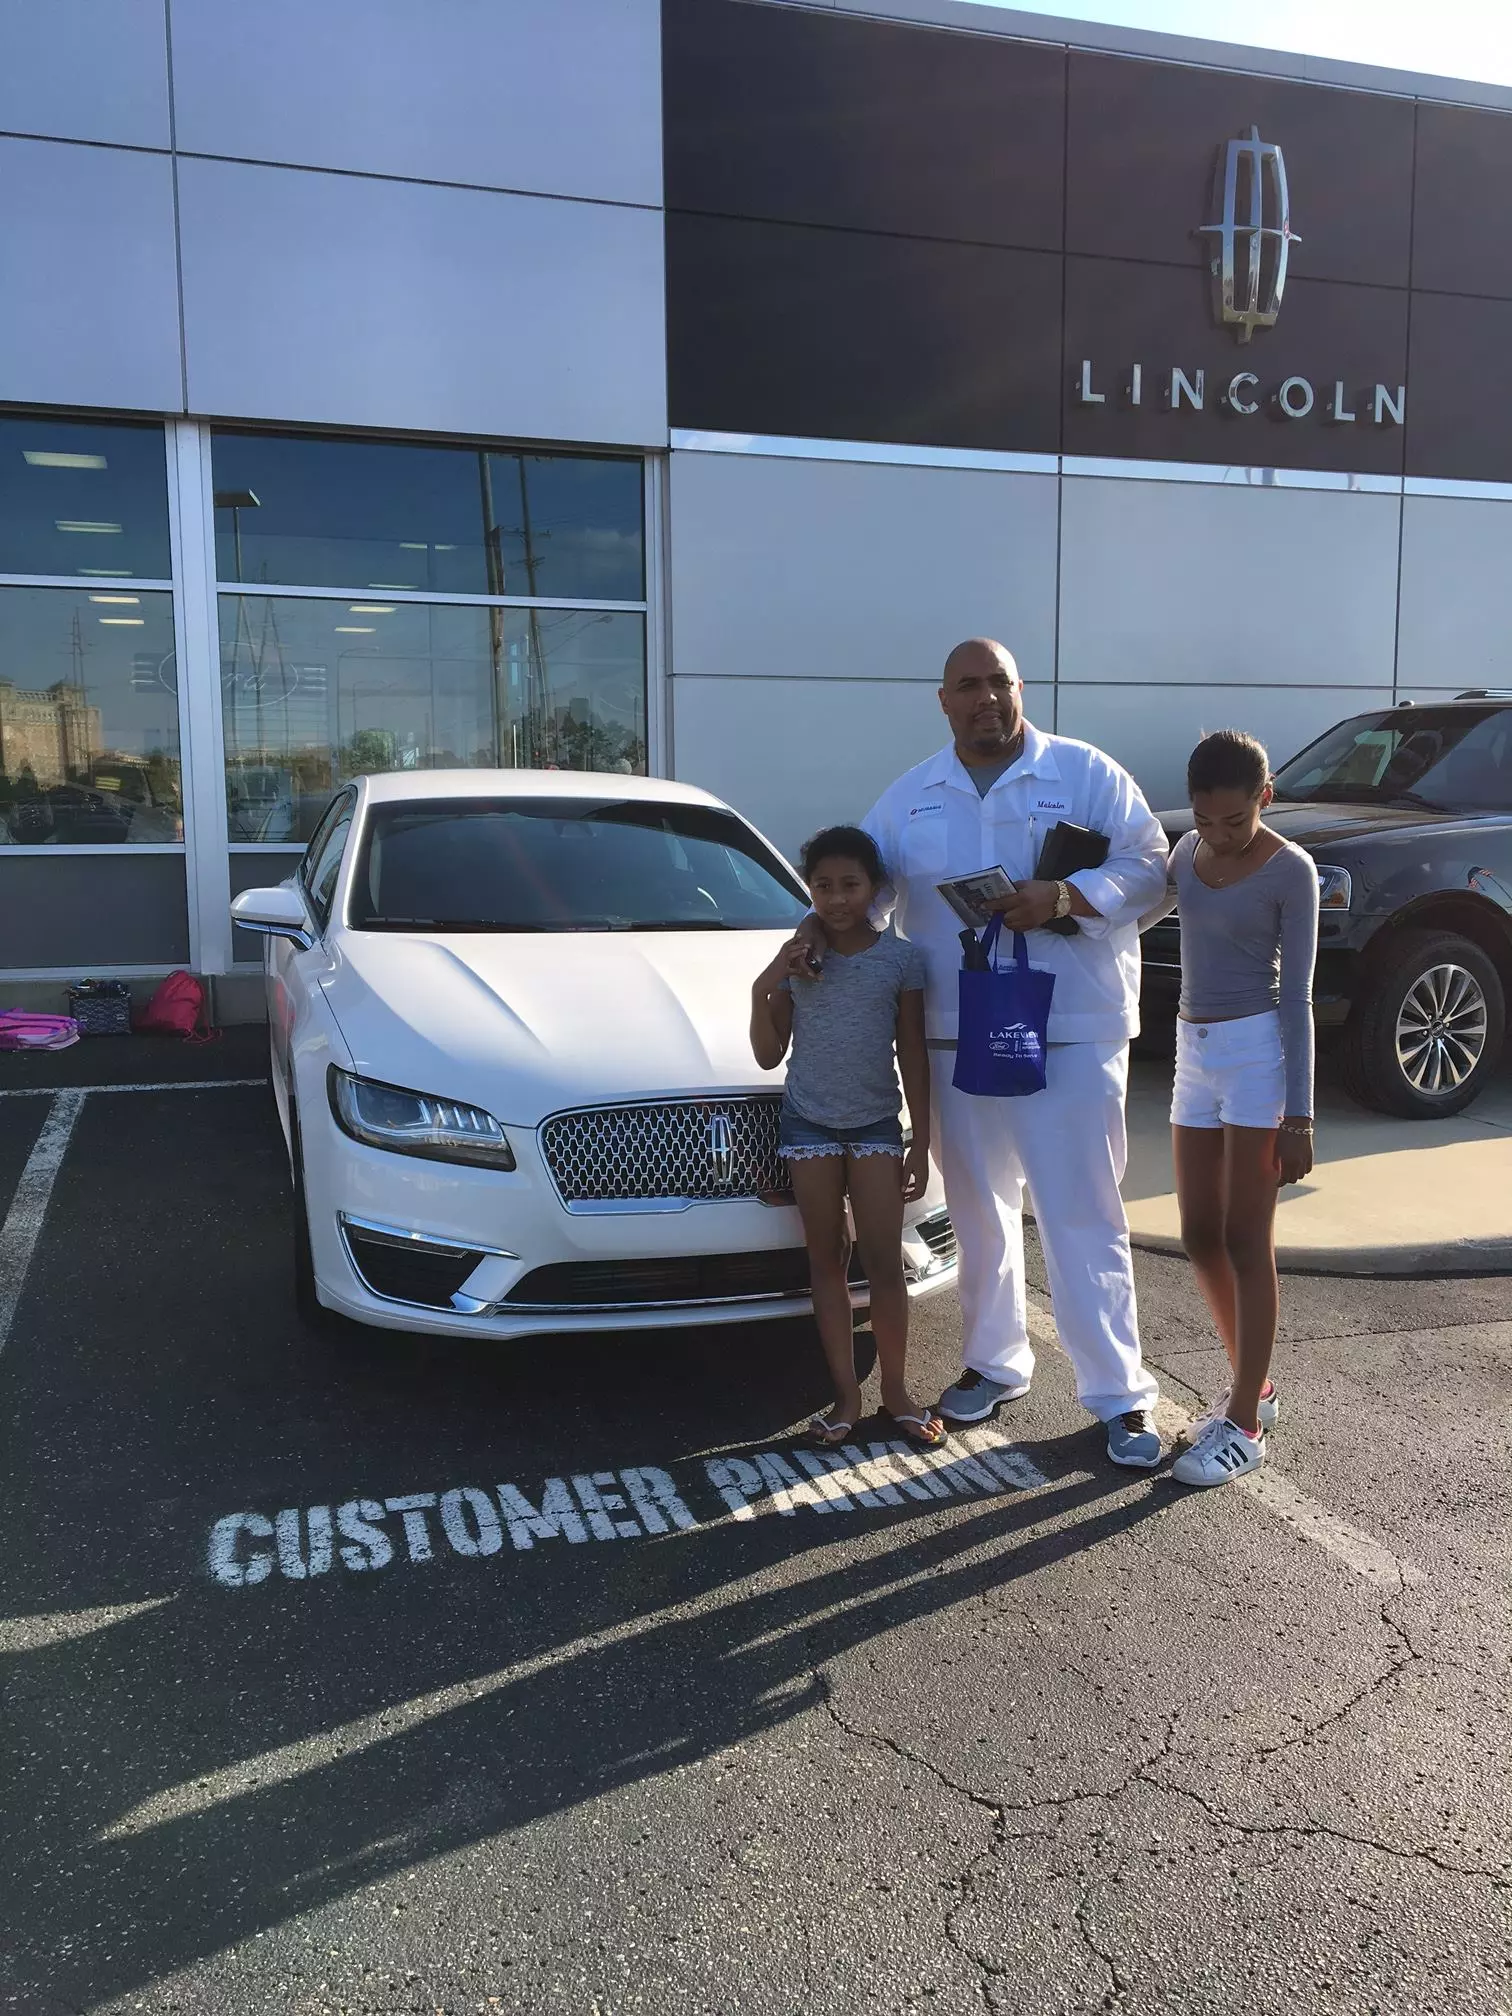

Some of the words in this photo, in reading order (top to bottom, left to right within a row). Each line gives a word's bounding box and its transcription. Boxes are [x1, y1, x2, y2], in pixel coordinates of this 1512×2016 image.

[1081, 360, 1405, 424] LINCOLN
[1037, 800, 1065, 809] Malcolm
[210, 1467, 699, 1587] CUSTOMER
[702, 1427, 1052, 1522] PARKING
